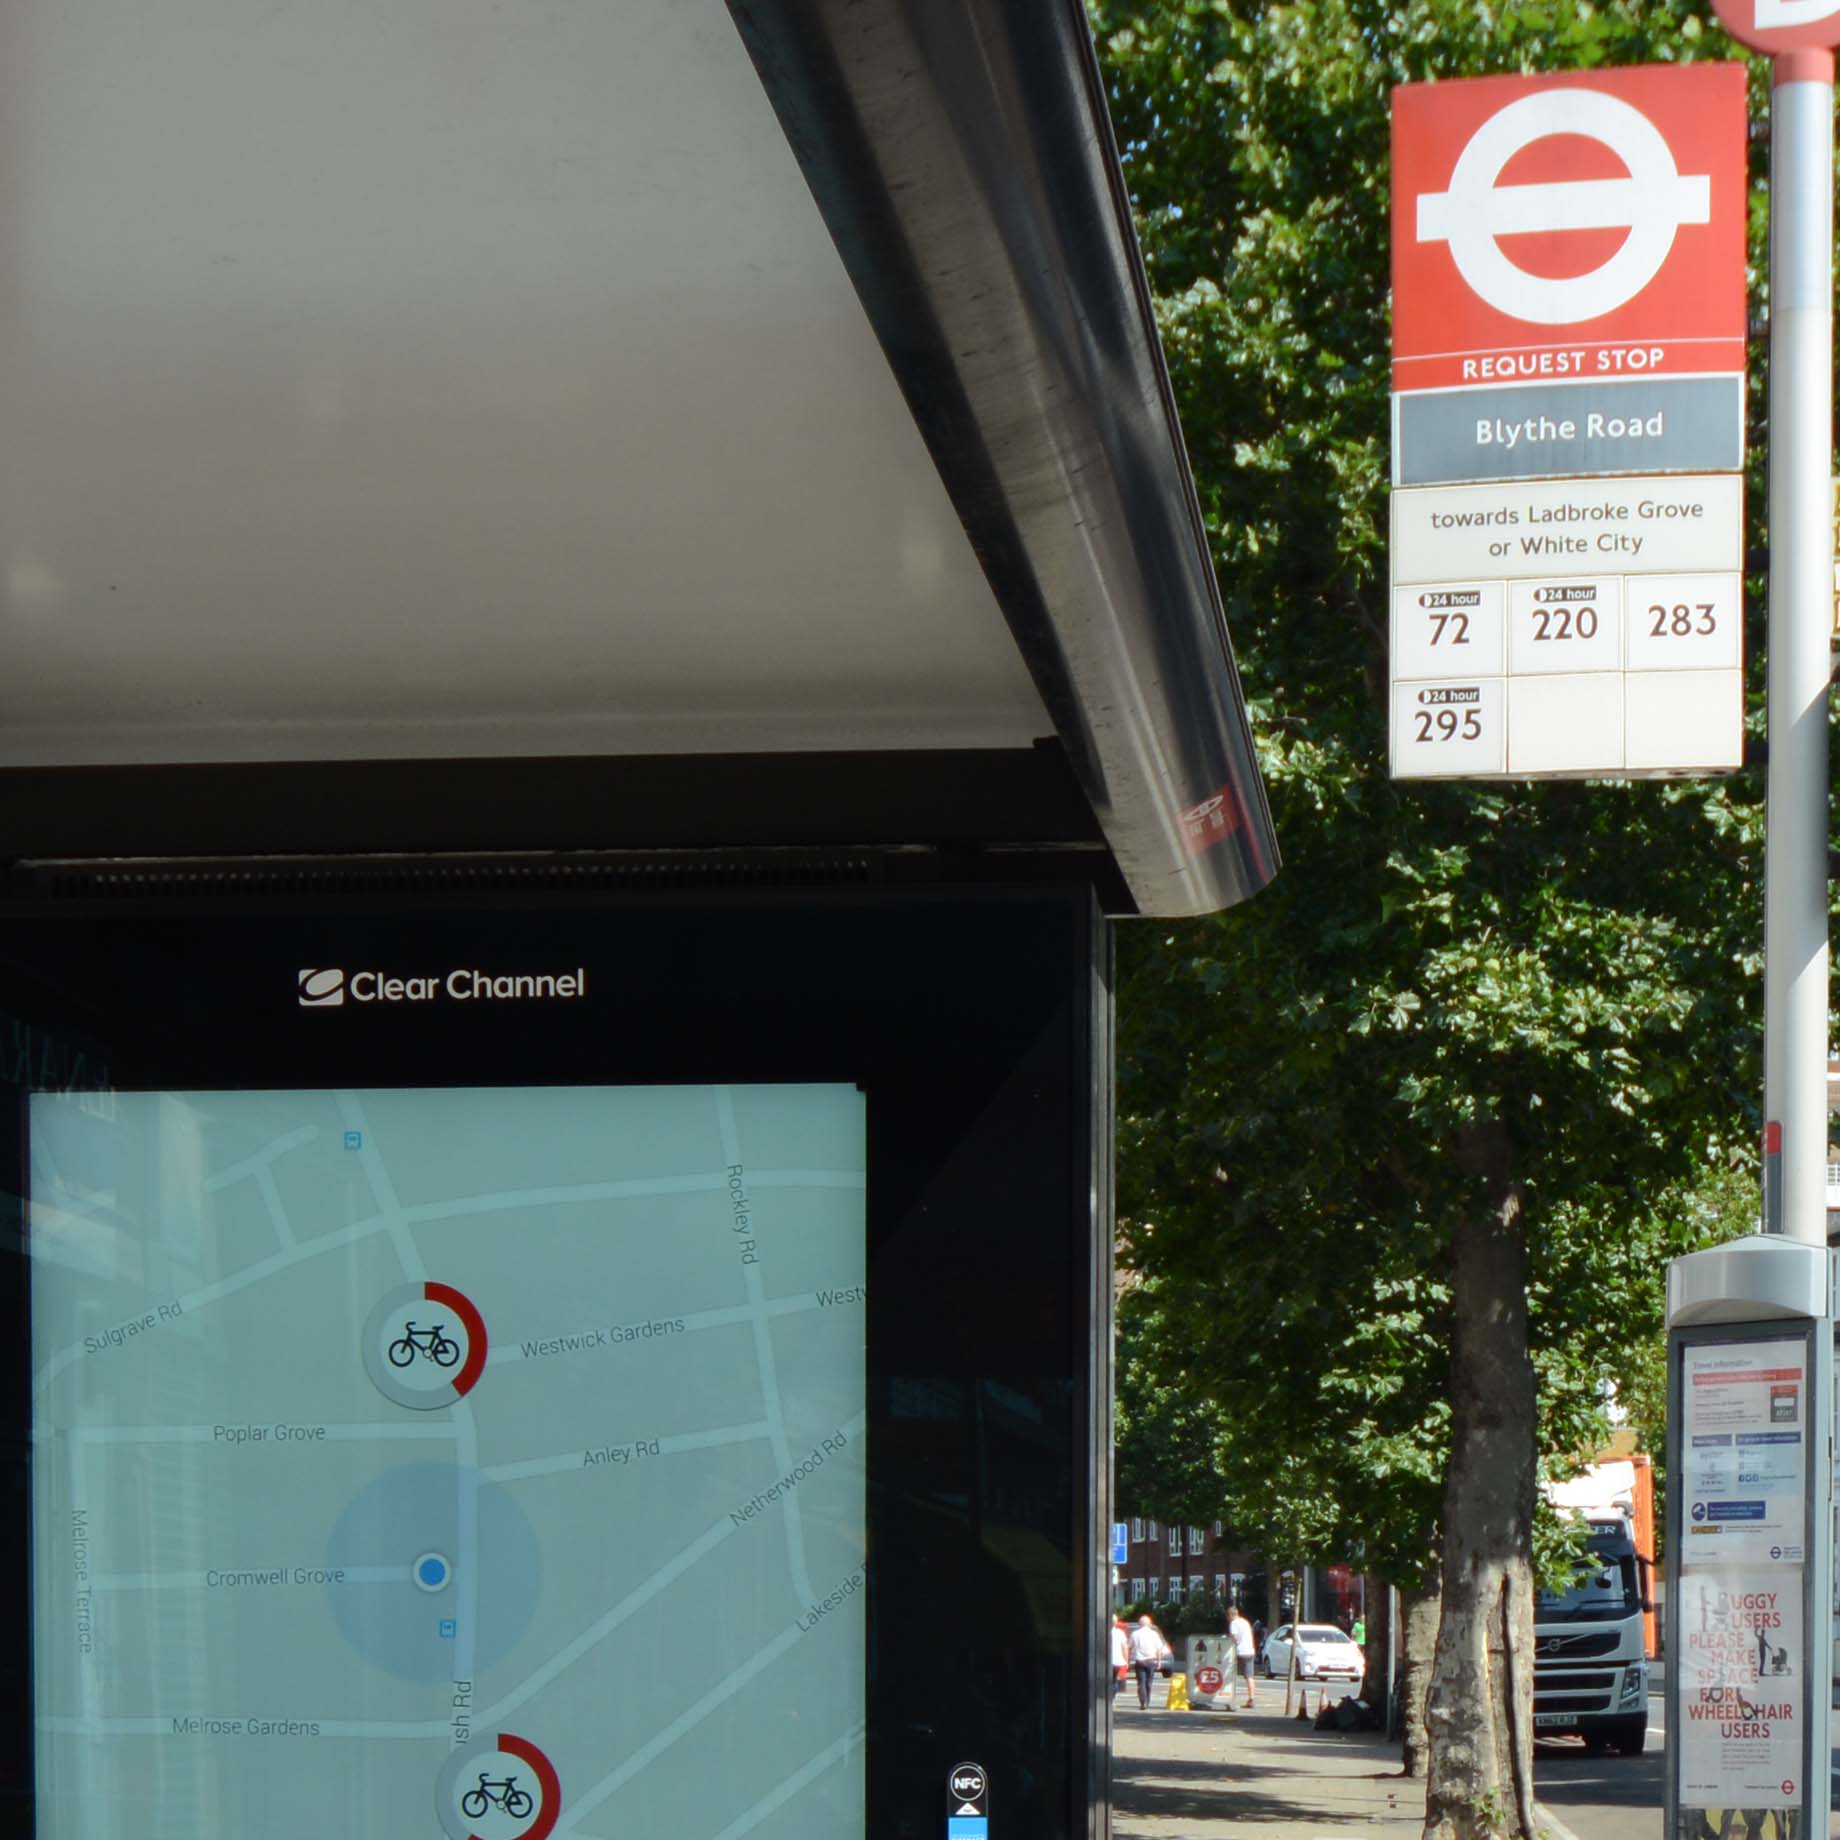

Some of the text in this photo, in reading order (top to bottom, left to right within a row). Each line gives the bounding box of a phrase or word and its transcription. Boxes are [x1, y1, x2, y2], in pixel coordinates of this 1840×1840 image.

[1463, 347, 1665, 380] REQUEST STOP
[1476, 412, 1664, 448] Blythe Road
[1432, 500, 1704, 529] towards Ladbroke Grove
[1490, 533, 1644, 556] or White City
[1431, 593, 1479, 607] 24 hour
[1548, 587, 1595, 601] 24 hour
[1428, 612, 1471, 646] 72
[1532, 606, 1598, 641] 220
[1648, 604, 1717, 637] 283
[1431, 688, 1478, 703] 24 hour
[1414, 708, 1482, 742] 295
[350, 967, 584, 1001] Clear Channel
[727, 1163, 759, 1265] Rockley Rd
[84, 1300, 184, 1355] Sulgrave Rd
[520, 1317, 686, 1359] Westwick Gardens
[214, 1424, 326, 1446] Poplar Grove
[583, 1439, 661, 1467] Anley Rd
[729, 1430, 848, 1528] Netherwood Rd
[71, 1508, 96, 1654] Melrose Terrace
[206, 1566, 345, 1587] Cromwell Grove
[795, 1570, 864, 1633] Lakeside
[1732, 1611, 1782, 1629] USERS
[1690, 1631, 1745, 1649] PLEASE
[1711, 1648, 1757, 1665] MAKE
[453, 1680, 473, 1708] Rd
[172, 1717, 320, 1736] Melrose Gardens
[1720, 1722, 1771, 1739] USERS
[954, 1777, 982, 1790] NFC
